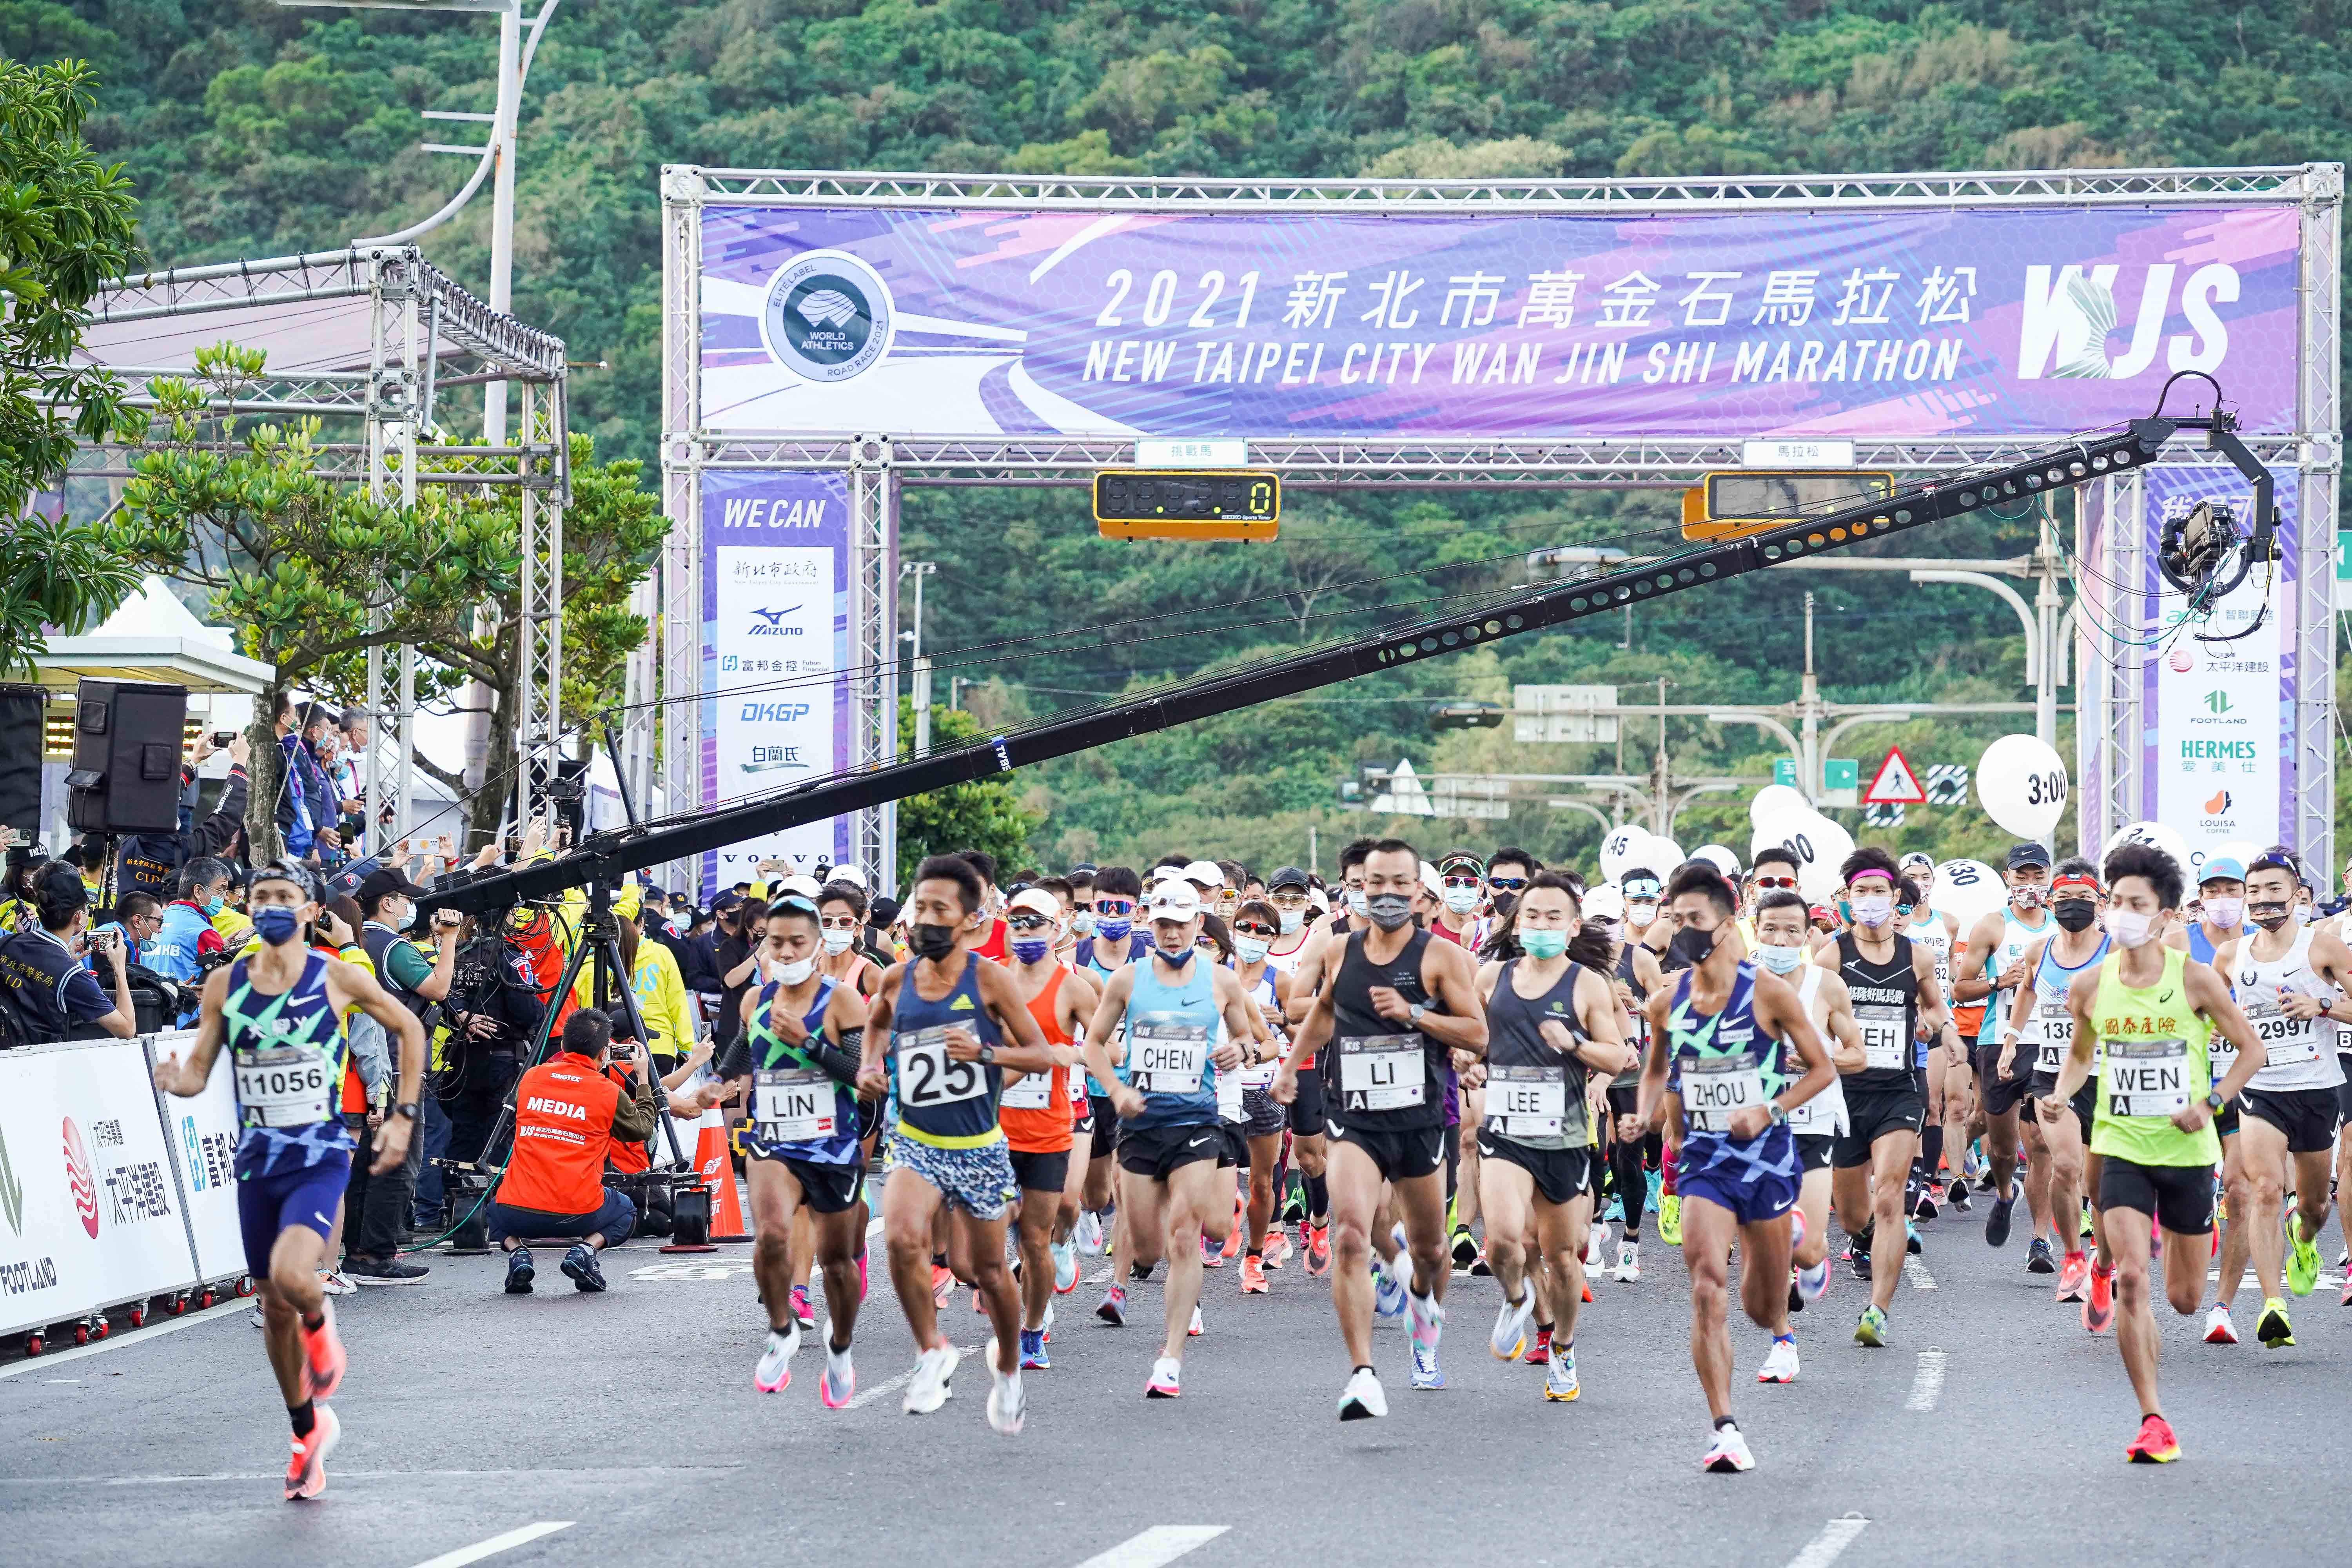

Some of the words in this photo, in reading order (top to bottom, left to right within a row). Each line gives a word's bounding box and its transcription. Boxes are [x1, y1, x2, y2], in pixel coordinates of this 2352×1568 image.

[773, 282, 789, 307] ELITE
[788, 265, 817, 283] LABEL
[1096, 269, 1260, 328] 2021
[1282, 266, 1976, 328] 新北市萬金石馬拉松
[2018, 263, 2240, 379] WJS
[801, 341, 854, 350] ATHLETICS
[809, 332, 845, 340] WORLD
[828, 364, 854, 376] ROAD
[855, 346, 875, 367] RACE
[873, 320, 883, 344] 2021
[1082, 341, 1176, 382] NEW
[1193, 342, 1324, 383] TAIPEI
[1340, 342, 1436, 384] CITY
[1452, 343, 1543, 384] WAN
[1553, 343, 1628, 384] JIN
[1643, 341, 1716, 383] SHI
[1731, 339, 1962, 383] MARATHON
[1171, 445, 1212, 457] 挑戰馬
[1778, 445, 1819, 457] 馬拉松
[724, 499, 768, 527] WE
[768, 499, 826, 528] CAN
[733, 561, 817, 578] 新北市政府
[742, 660, 797, 671] 富邦金控
[2206, 661, 2269, 673] 太平洋建設
[741, 704, 809, 721] DKGP
[752, 746, 799, 762] 白蘭氏
[996, 745, 1011, 771] TVBS
[2181, 740, 2256, 759] HERMES
[2181, 760, 2256, 773] 愛美仕
[2028, 769, 2066, 804] 3:00
[723, 854, 829, 863] VOLVO
[136, 872, 160, 883] CID
[1860, 1028, 1895, 1047] EH
[2251, 1018, 2312, 1040] 2997
[1144, 1048, 1192, 1070] CHEN
[2047, 1049, 2058, 1063] A
[241, 1068, 323, 1095] 11056
[908, 1049, 976, 1103] 25
[1135, 1072, 1149, 1089] A
[1371, 1062, 1395, 1085] LI
[2114, 1067, 2180, 1091] WEN
[1349, 1091, 1366, 1110] A
[1508, 1091, 1539, 1113] LEE
[1693, 1081, 1746, 1107] ZHOU
[526, 1097, 586, 1121] MEDIA
[772, 1094, 815, 1117] LIN
[2113, 1096, 2129, 1115] A
[250, 1107, 265, 1127] A
[1489, 1116, 1505, 1134] A
[1693, 1111, 1707, 1130] A
[763, 1123, 777, 1141] A
[105, 1162, 171, 1226] 太平洋建設
[0, 1257, 56, 1296] FOOTLAND
